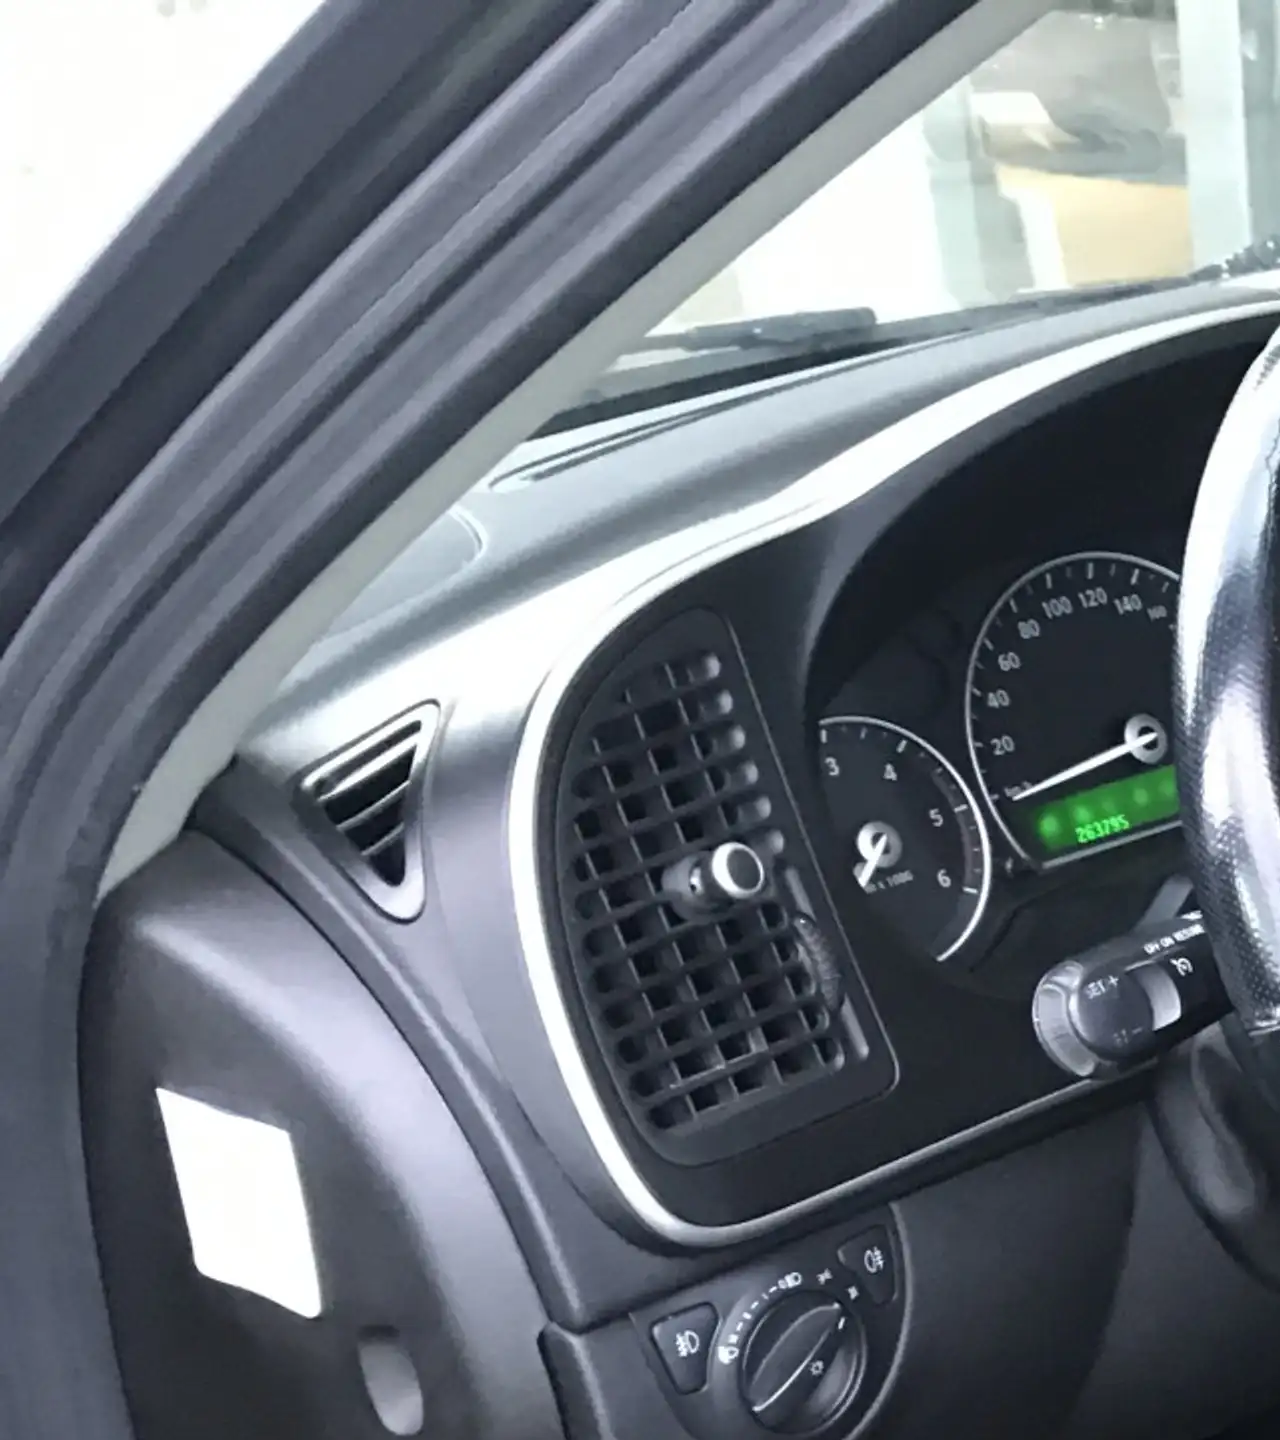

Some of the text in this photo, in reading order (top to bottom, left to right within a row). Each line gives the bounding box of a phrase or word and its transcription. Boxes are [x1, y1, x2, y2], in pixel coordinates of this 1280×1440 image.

[1079, 587, 1107, 608] 120
[1114, 594, 1142, 615] 140
[1042, 596, 1073, 619] 100
[1018, 619, 1040, 639] 80
[998, 652, 1021, 671] 60
[987, 690, 1010, 708] 40
[990, 736, 1014, 755] 20
[824, 757, 839, 776] 3
[883, 763, 897, 781] 4
[929, 808, 943, 827] 5
[937, 869, 951, 888] 6
